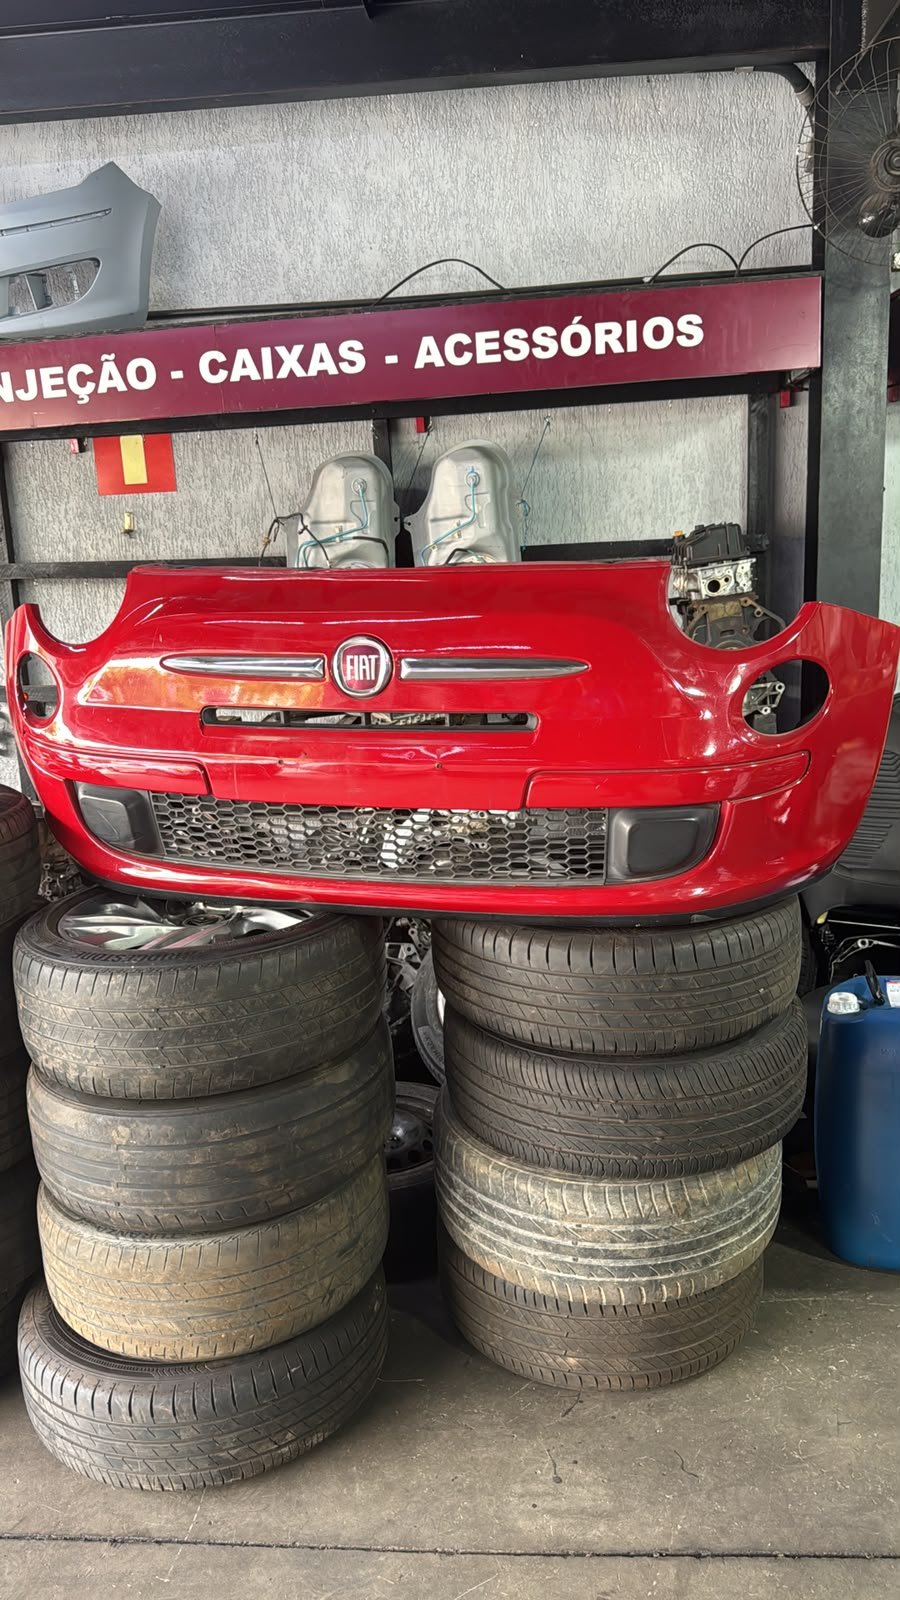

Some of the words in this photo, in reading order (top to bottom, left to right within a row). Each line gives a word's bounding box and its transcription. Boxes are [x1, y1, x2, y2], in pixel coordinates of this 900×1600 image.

[170, 369, 184, 380] -
[198, 339, 367, 384] CAIXAS
[384, 354, 399, 365] -
[413, 313, 705, 370] ACESSÓRIOS
[345, 654, 379, 681] FIAT
